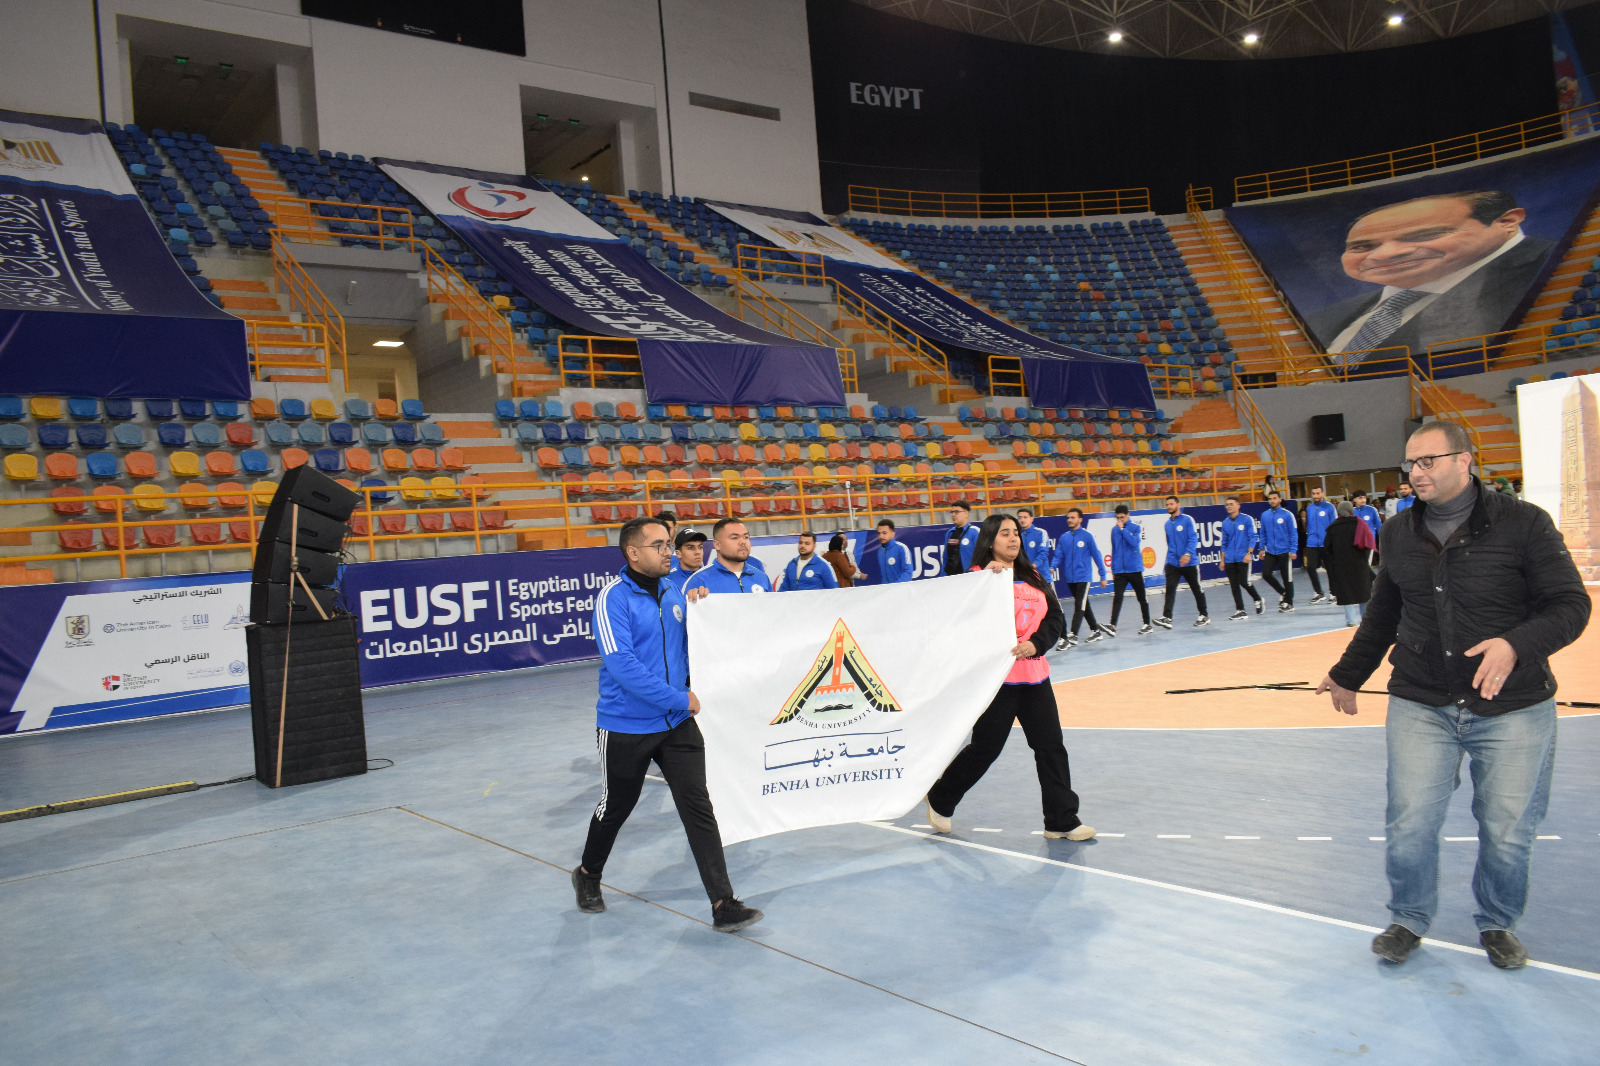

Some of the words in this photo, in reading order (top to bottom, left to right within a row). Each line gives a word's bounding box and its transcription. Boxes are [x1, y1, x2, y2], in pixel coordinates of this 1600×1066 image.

[850, 82, 924, 110] EGYPT
[56, 199, 88, 229] Sports
[64, 230, 93, 249] and
[73, 252, 107, 277] Youth
[84, 279, 113, 287] of
[132, 590, 188, 605] الاستراتيجي
[190, 587, 222, 597] الشريك
[508, 575, 580, 600] Egyptian
[360, 581, 490, 633] EUSF
[509, 600, 564, 621] Sports
[365, 631, 458, 659] للجامعات
[463, 623, 538, 654] المصرى
[144, 655, 181, 669] الرسمي
[183, 653, 210, 663] الناقل
[796, 715, 818, 729] BENHA
[821, 707, 872, 729] UNIVERSITY
[764, 748, 834, 771] بنها
[839, 736, 906, 762] جامعة
[762, 778, 810, 796] BENHA
[815, 767, 904, 788] UNIVERSITY
